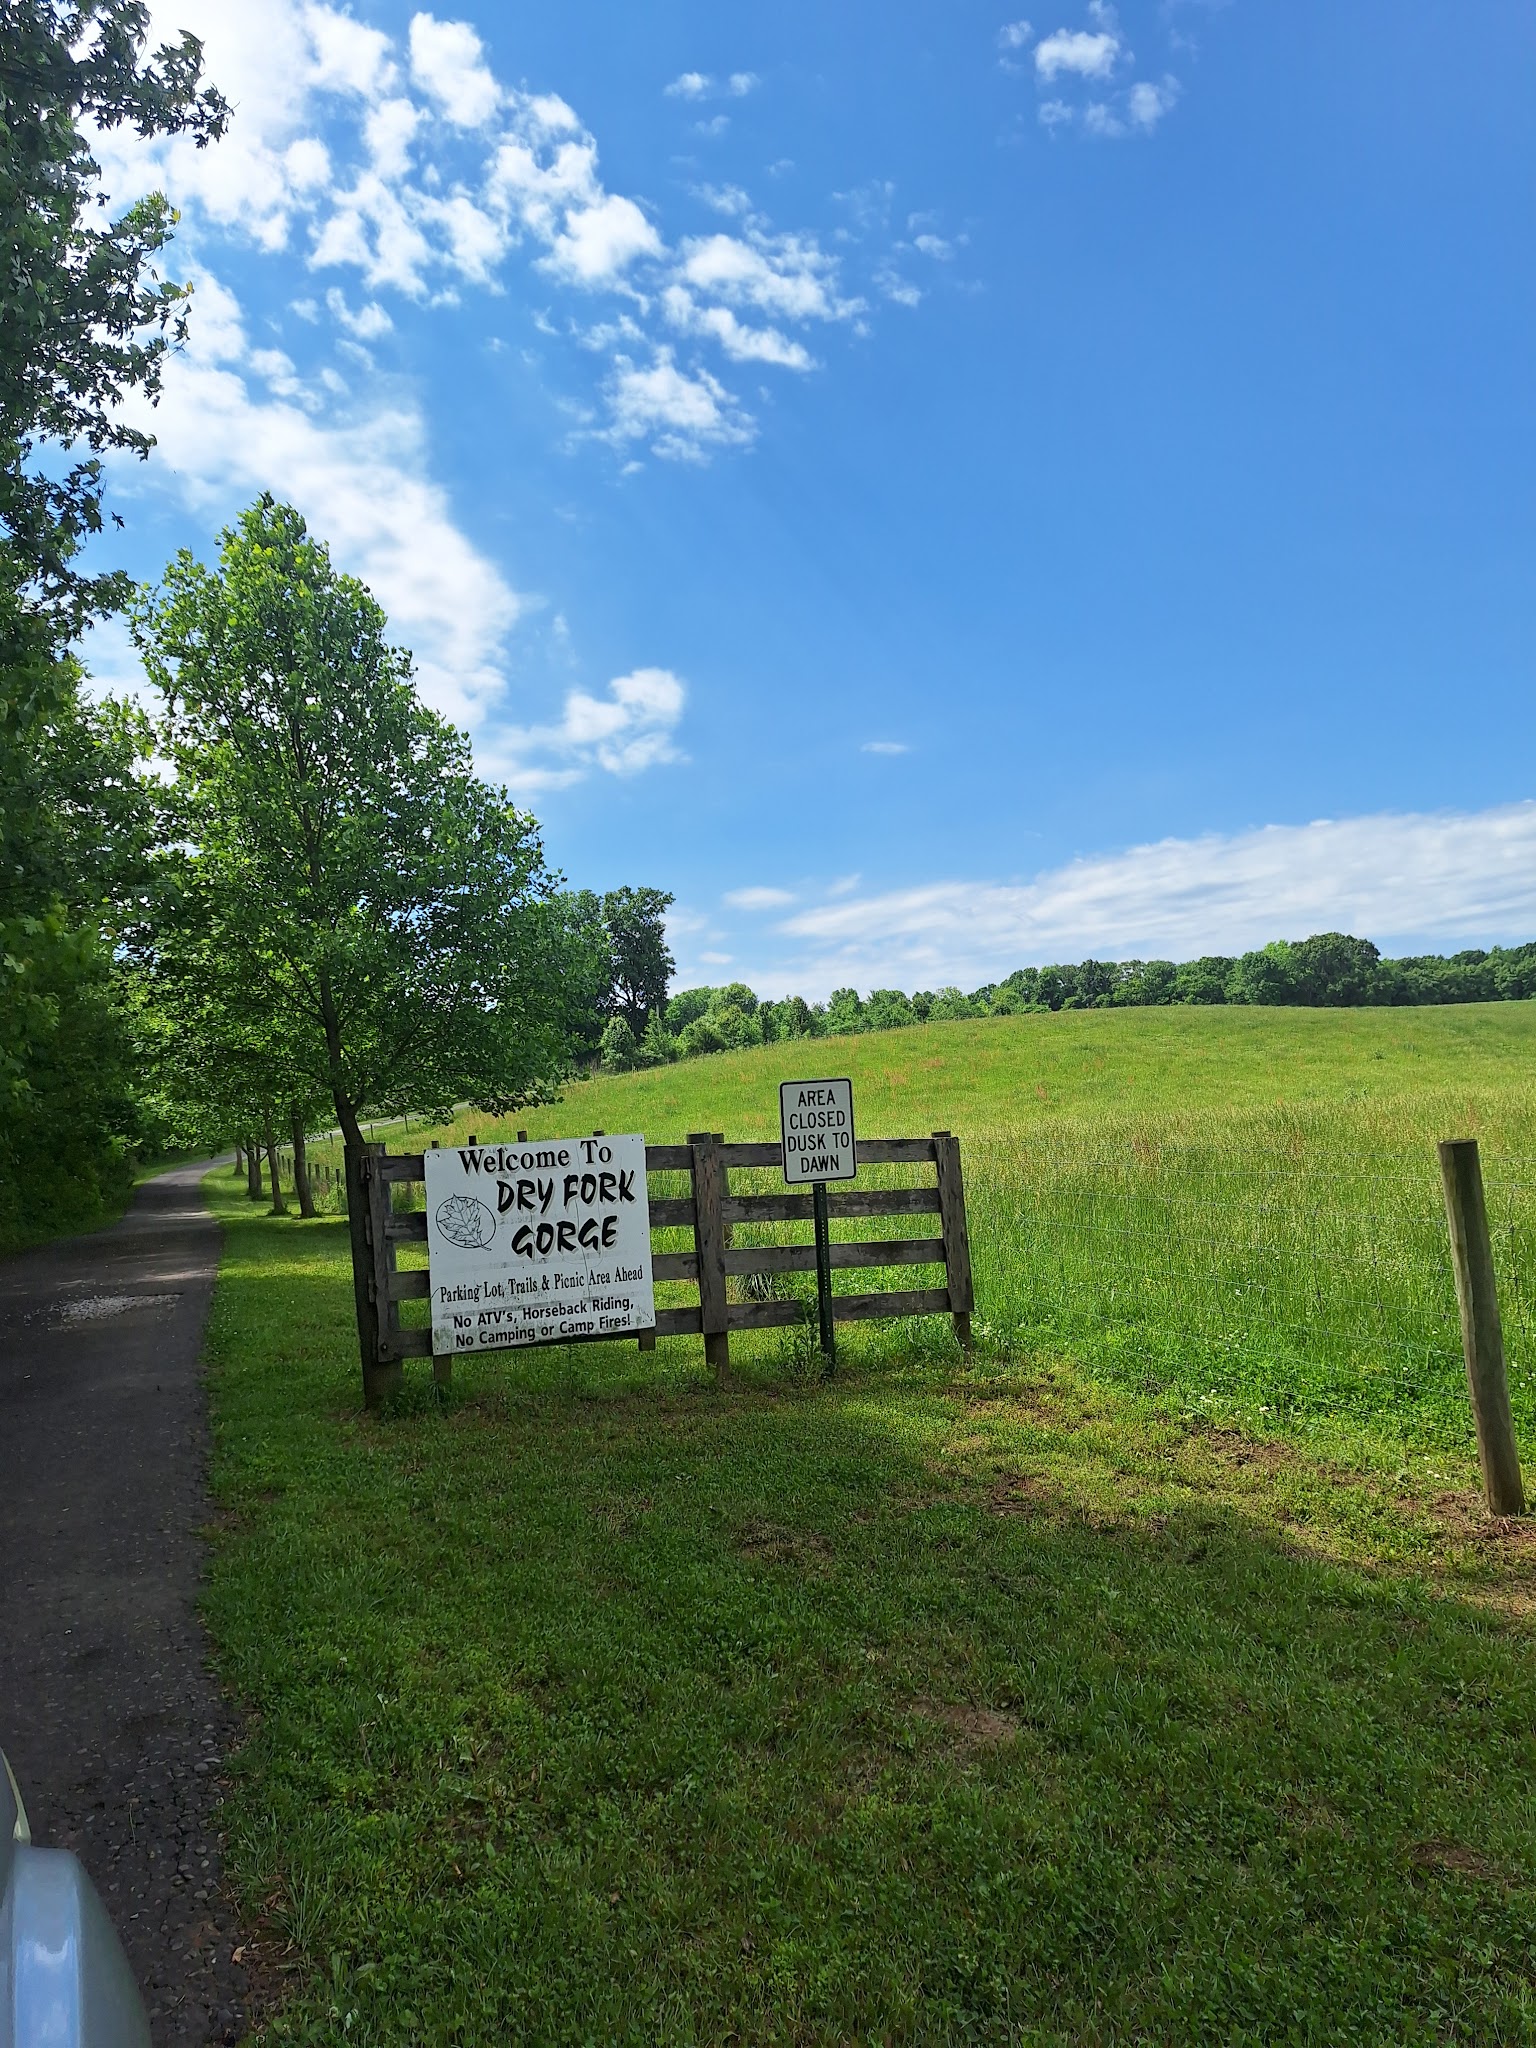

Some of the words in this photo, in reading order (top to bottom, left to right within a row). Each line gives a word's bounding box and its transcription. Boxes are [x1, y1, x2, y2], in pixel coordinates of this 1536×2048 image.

[798, 1089, 835, 1107] AREA
[790, 1111, 845, 1129] CLOSED
[458, 1147, 569, 1175] Welcome
[580, 1140, 612, 1164] To
[788, 1134, 826, 1152] DUSK
[832, 1132, 849, 1148] TO
[801, 1155, 839, 1173] DAWN
[497, 1177, 553, 1214] DRY
[563, 1169, 635, 1209] FORK
[511, 1215, 617, 1259] GORGE
[440, 1285, 481, 1303] Parking
[484, 1281, 505, 1297] Lot,
[508, 1277, 538, 1293] Trails
[542, 1275, 550, 1290] &
[554, 1272, 585, 1289] Picnic
[589, 1269, 611, 1285] Area
[615, 1265, 643, 1282] Ahead
[454, 1315, 471, 1328] No
[478, 1310, 517, 1325] ATV's,
[523, 1300, 587, 1320] Horseback
[592, 1297, 634, 1312] Riding,
[456, 1334, 473, 1347] No
[479, 1328, 535, 1345] Camping
[541, 1324, 554, 1336] or
[560, 1319, 594, 1334] Camp
[600, 1314, 630, 1329] Fires!
